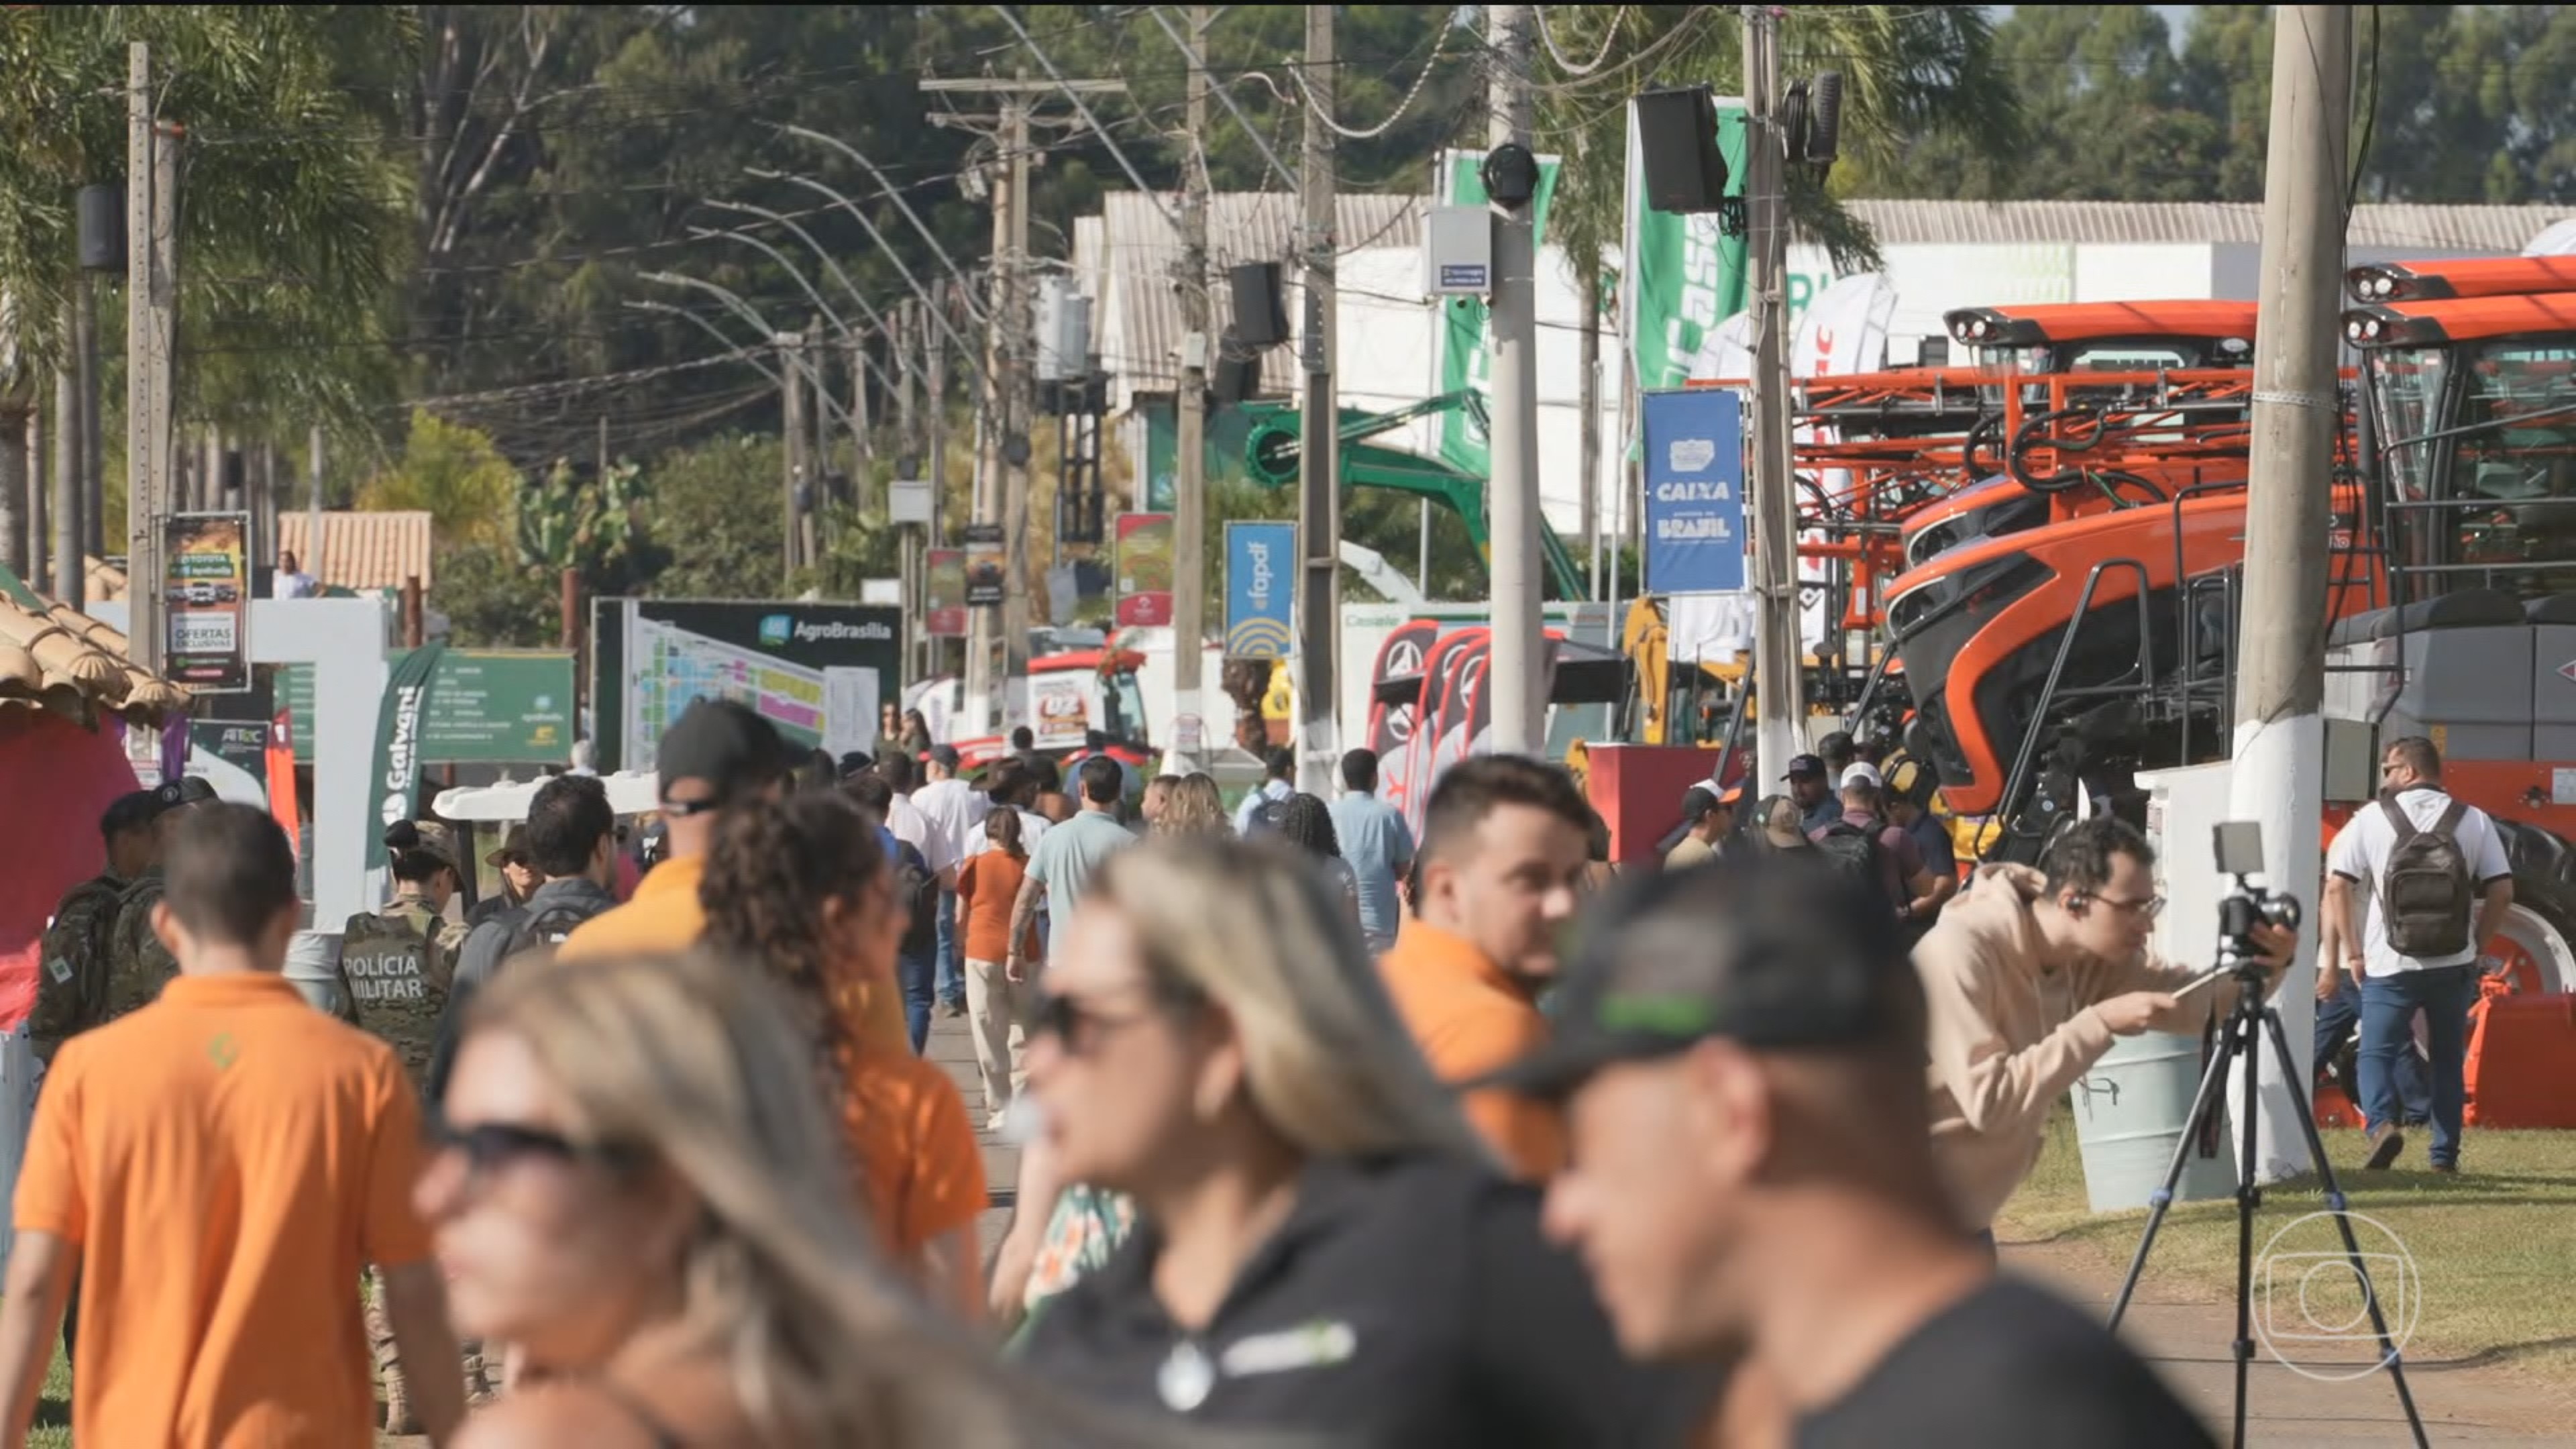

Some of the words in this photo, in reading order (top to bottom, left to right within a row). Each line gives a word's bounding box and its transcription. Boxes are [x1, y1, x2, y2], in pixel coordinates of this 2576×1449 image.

[1656, 482, 1730, 502] CAIXA
[1657, 518, 1731, 539] BRASIL
[1247, 541, 1274, 598] fapdf
[176, 628, 231, 639] OFERTAS
[386, 686, 416, 790] Galvani
[342, 952, 419, 977] POLÍCIA
[350, 979, 424, 999] MILITAR
